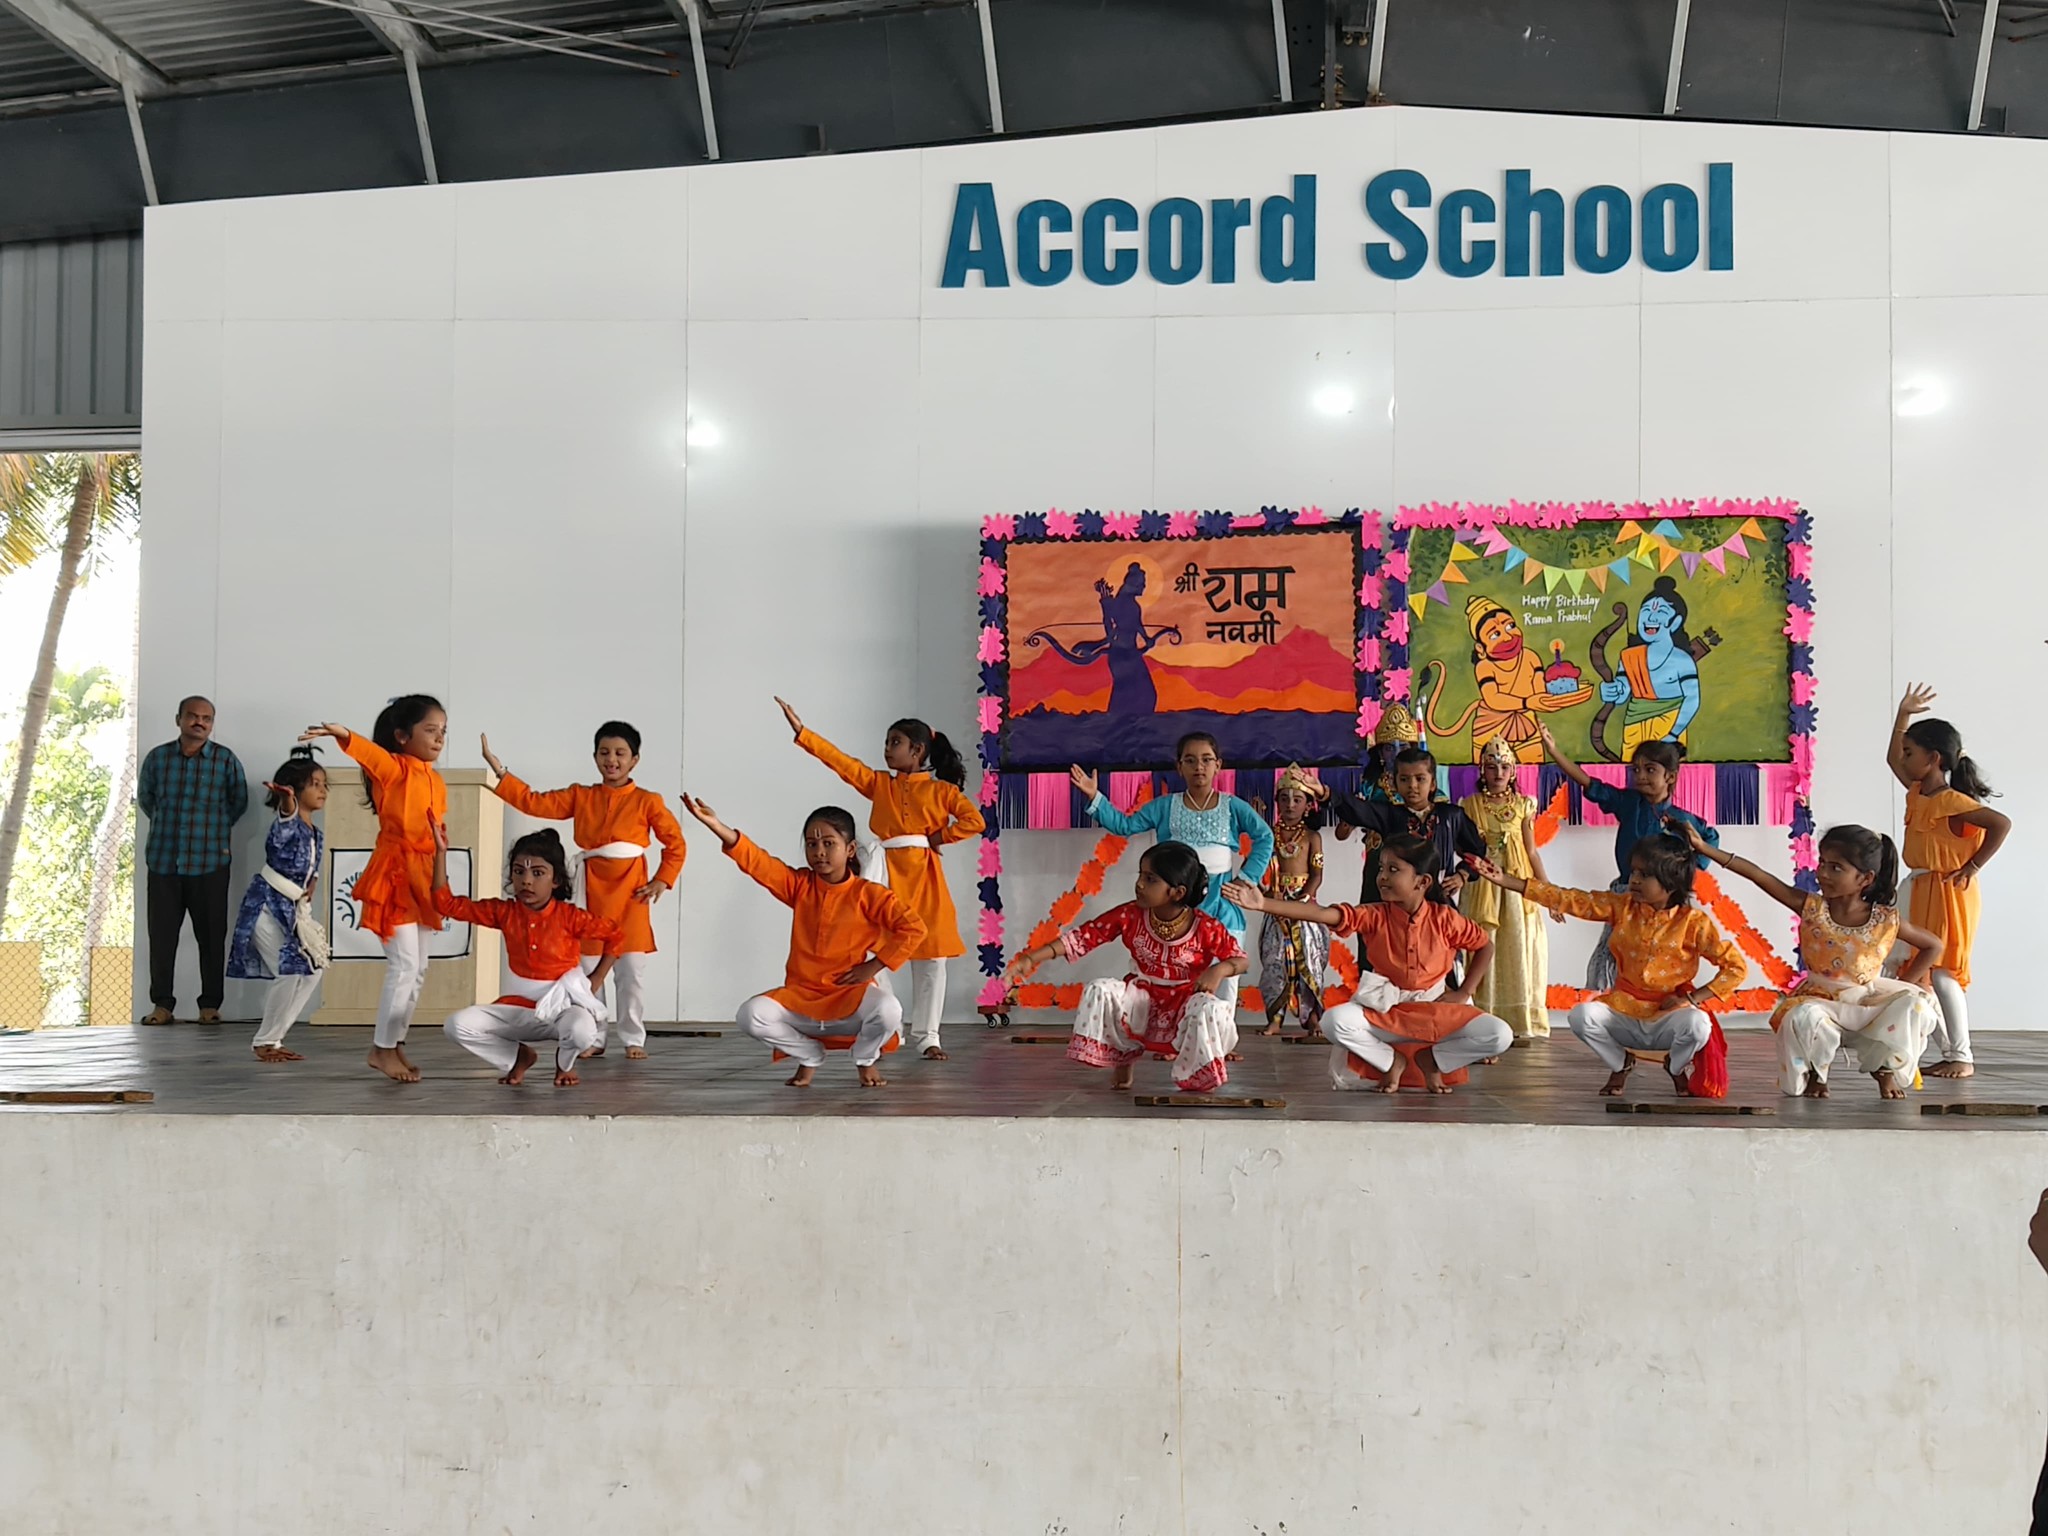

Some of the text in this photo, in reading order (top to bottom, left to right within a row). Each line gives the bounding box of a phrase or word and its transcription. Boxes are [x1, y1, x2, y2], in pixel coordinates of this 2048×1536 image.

[940, 162, 1734, 289] Accord School
[1173, 562, 1296, 613] श्री राम
[1522, 593, 1600, 612] Happy Birthday
[1205, 610, 1281, 645] नवमी
[1523, 609, 1592, 626] Rama Prabhu!
